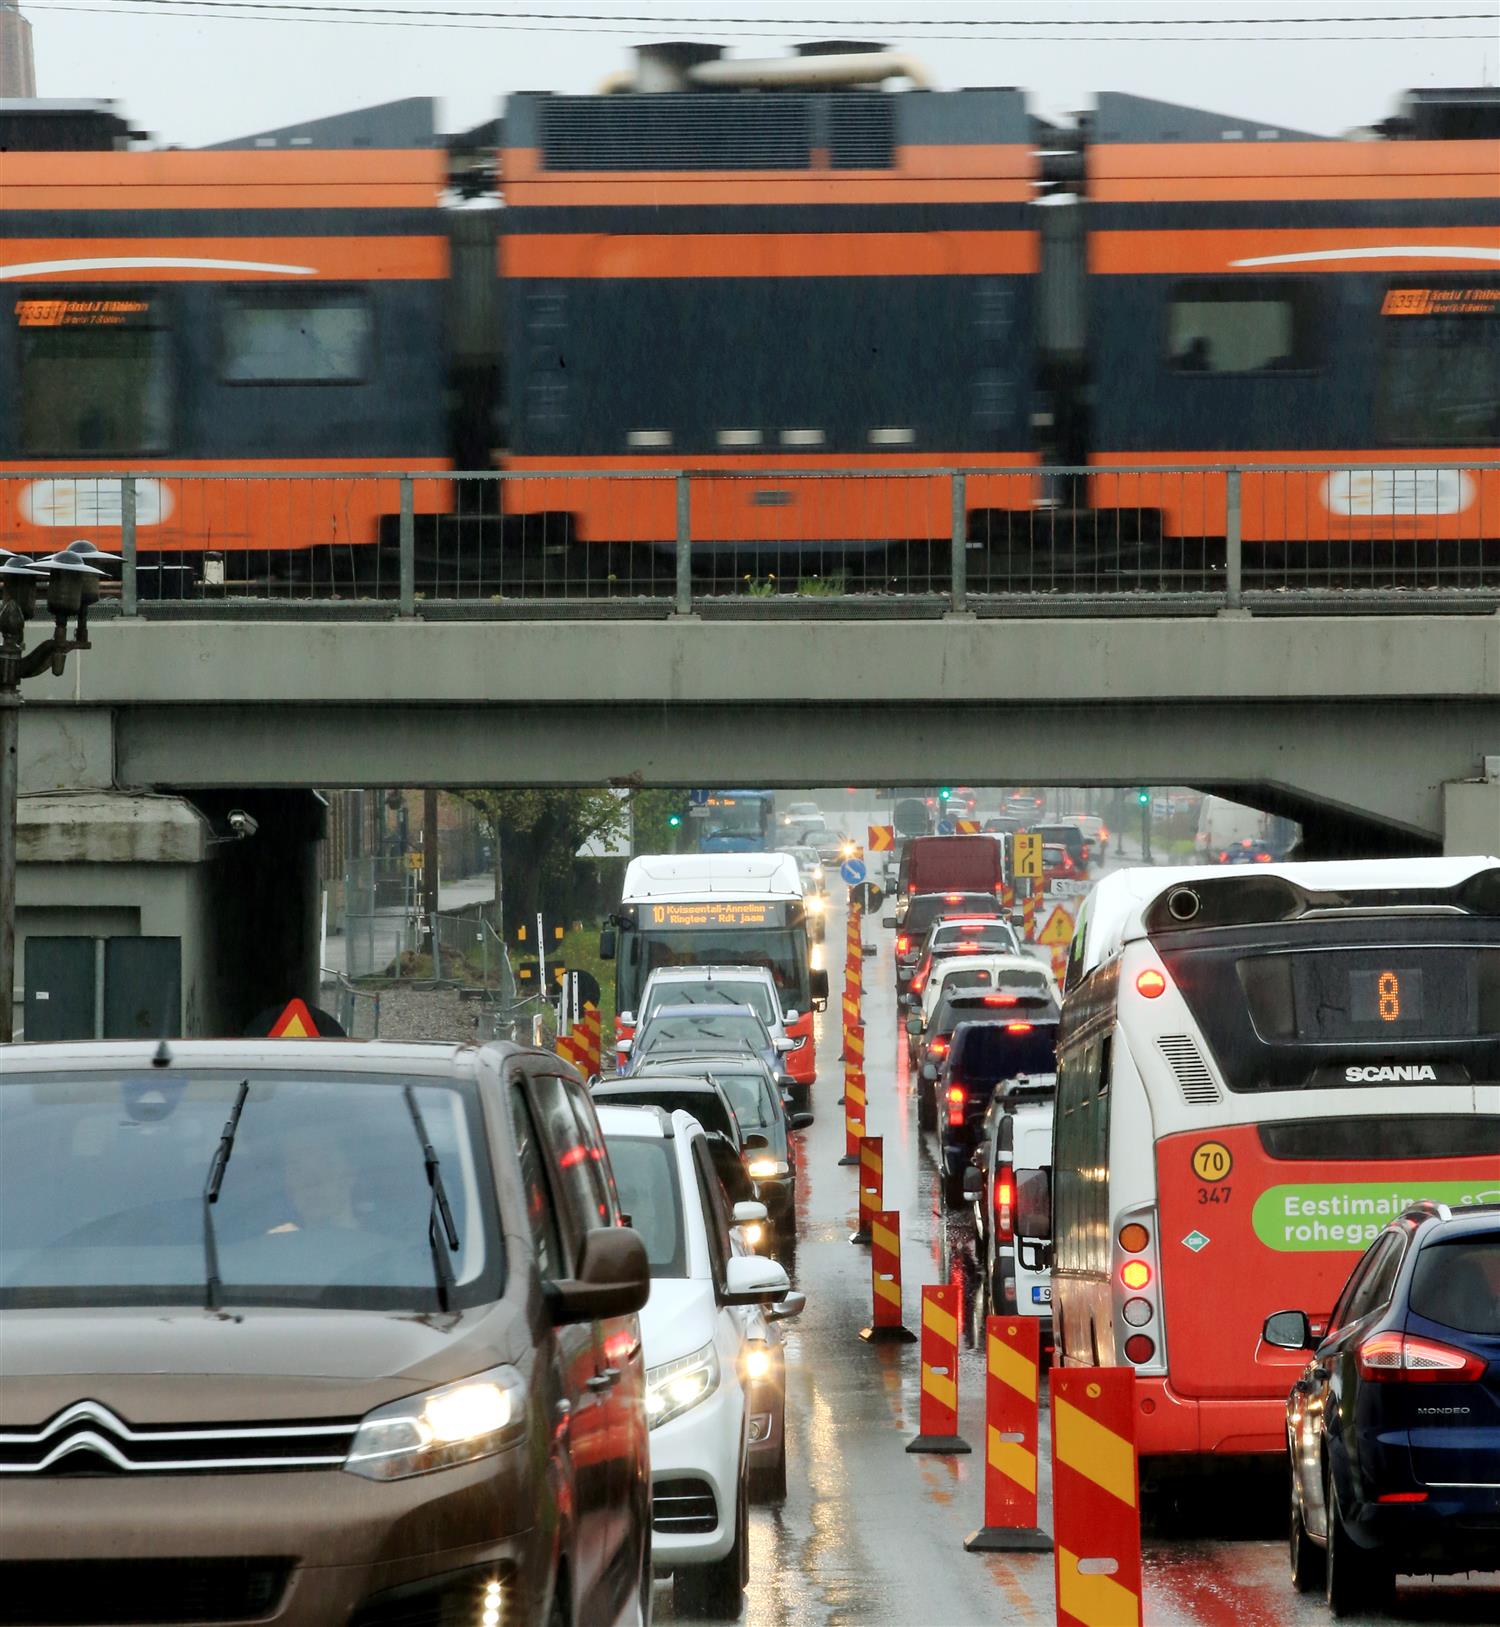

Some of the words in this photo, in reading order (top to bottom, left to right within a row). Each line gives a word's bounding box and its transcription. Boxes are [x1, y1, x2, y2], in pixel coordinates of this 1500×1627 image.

[653, 904, 665, 923] 10
[1378, 972, 1399, 1021] 8
[1345, 1065, 1437, 1082] SCANIA
[1200, 1152, 1223, 1172] 70
[1198, 1187, 1232, 1204] 347
[1285, 1220, 1385, 1245] rohega
[1417, 1407, 1470, 1415] MONDEO
